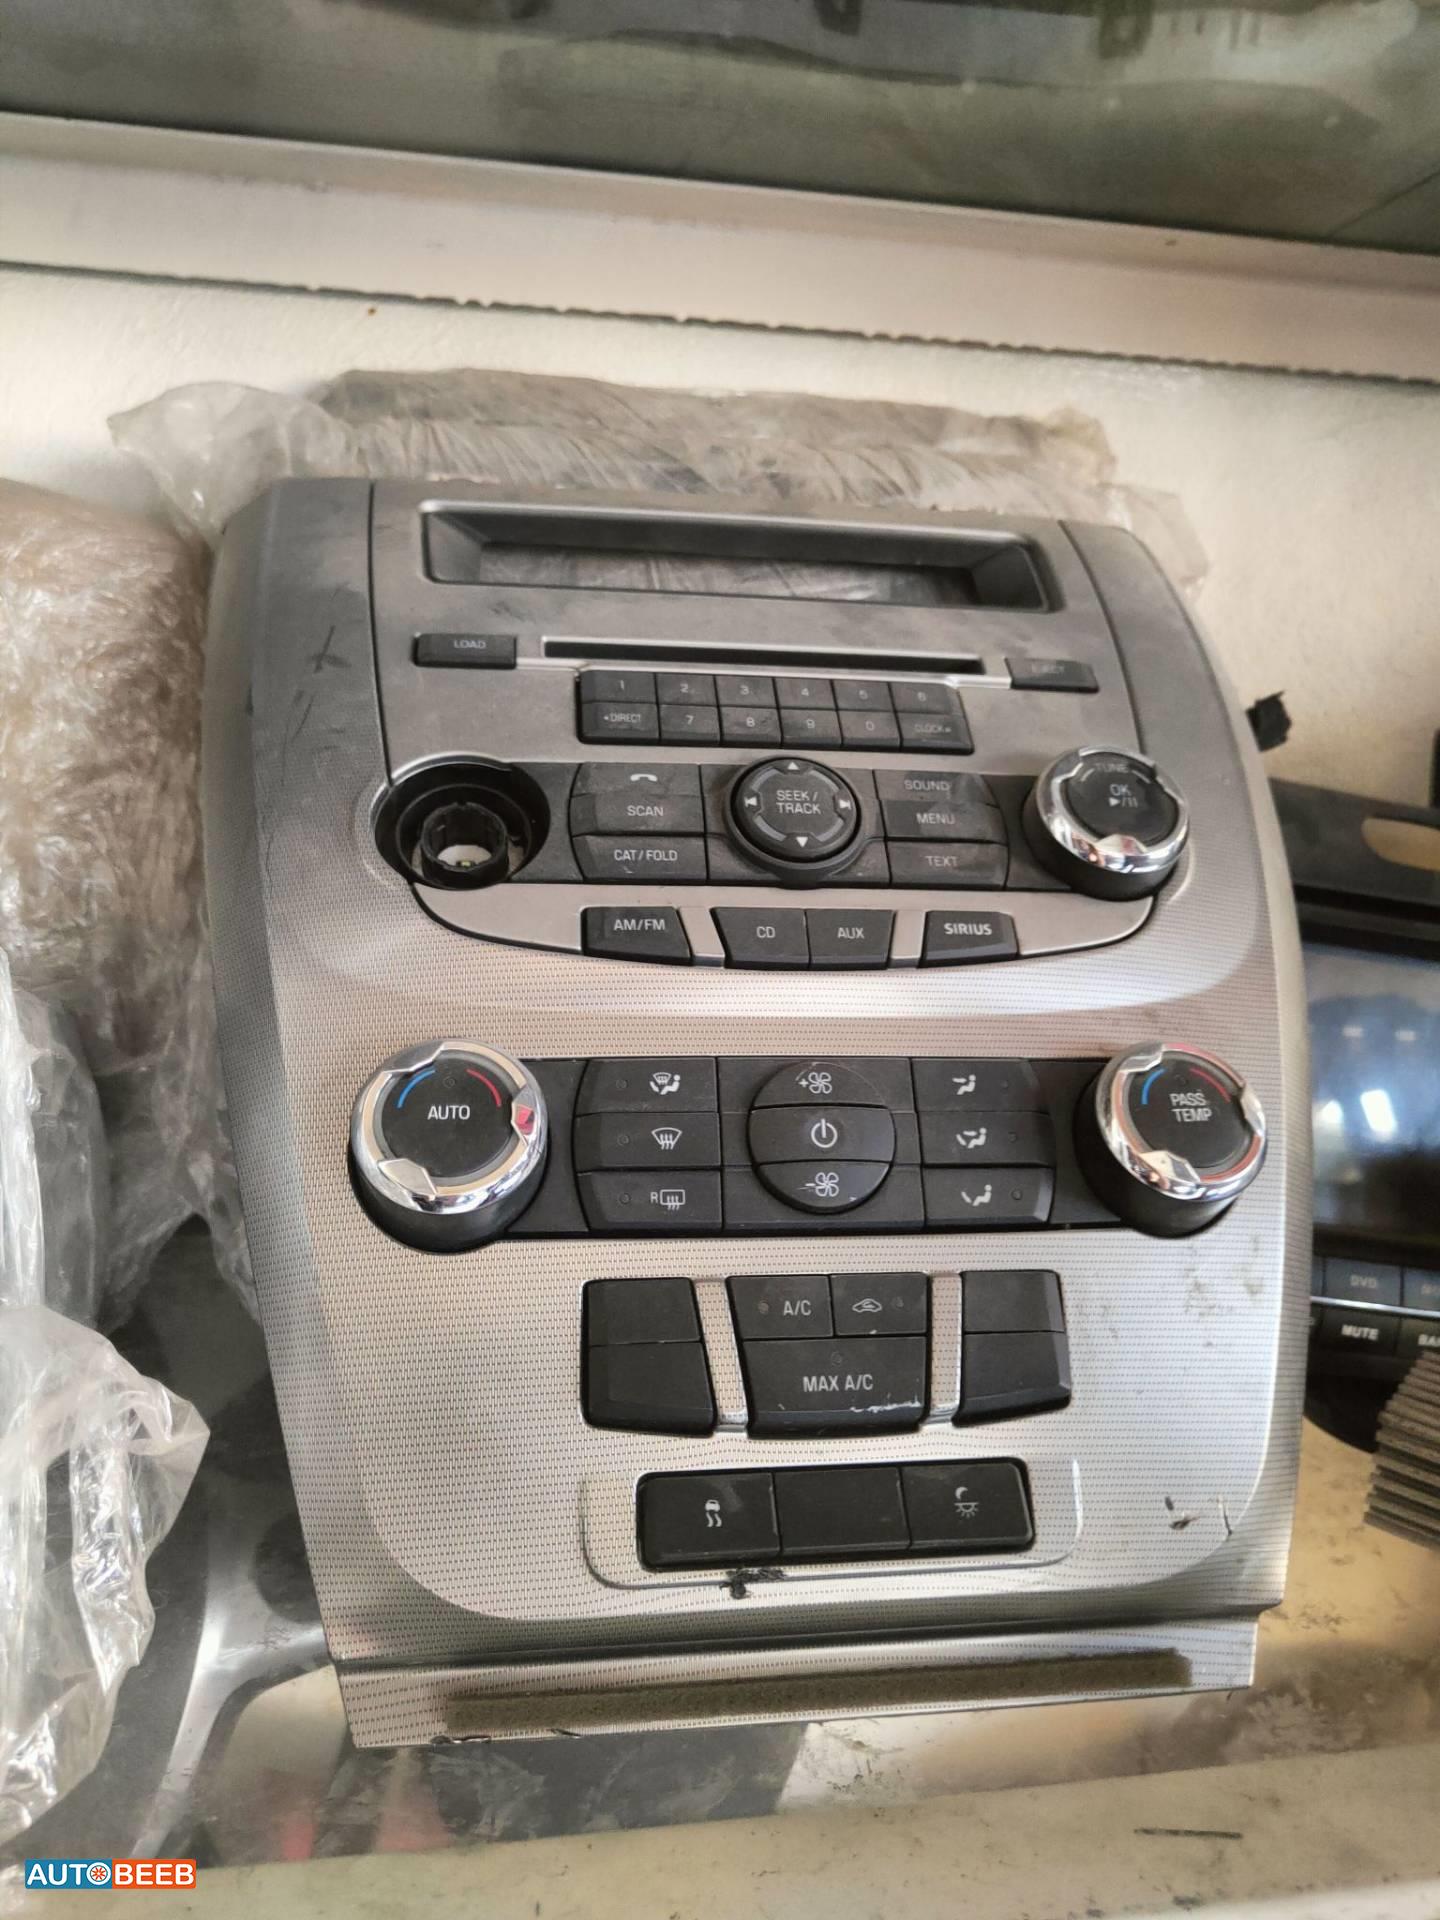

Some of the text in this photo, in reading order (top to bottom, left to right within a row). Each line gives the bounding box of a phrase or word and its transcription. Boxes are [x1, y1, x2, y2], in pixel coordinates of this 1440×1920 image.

[453, 639, 486, 649] LOAD
[680, 684, 688, 693] 2
[740, 686, 749, 695] 3
[801, 688, 809, 696] 4
[685, 715, 694, 724] 7
[904, 779, 950, 791] SOUND
[1110, 783, 1131, 796] OK
[627, 805, 663, 817] SCAN
[776, 803, 821, 815] TRACK
[916, 813, 955, 825] MENU
[925, 856, 958, 868] TEXT
[613, 918, 666, 931] AM/FM
[943, 922, 992, 935] SIRIUS
[756, 926, 776, 939] CD
[837, 927, 865, 939] AUX
[1169, 1092, 1206, 1107] PASS
[427, 1105, 470, 1121] AUTO
[1172, 1108, 1212, 1122] TEMP
[650, 1192, 658, 1204] R
[1350, 1274, 1377, 1288] DVD
[783, 1300, 811, 1316] A/C
[1341, 1324, 1379, 1340] MUTE
[803, 1374, 873, 1392] MAX A/C
